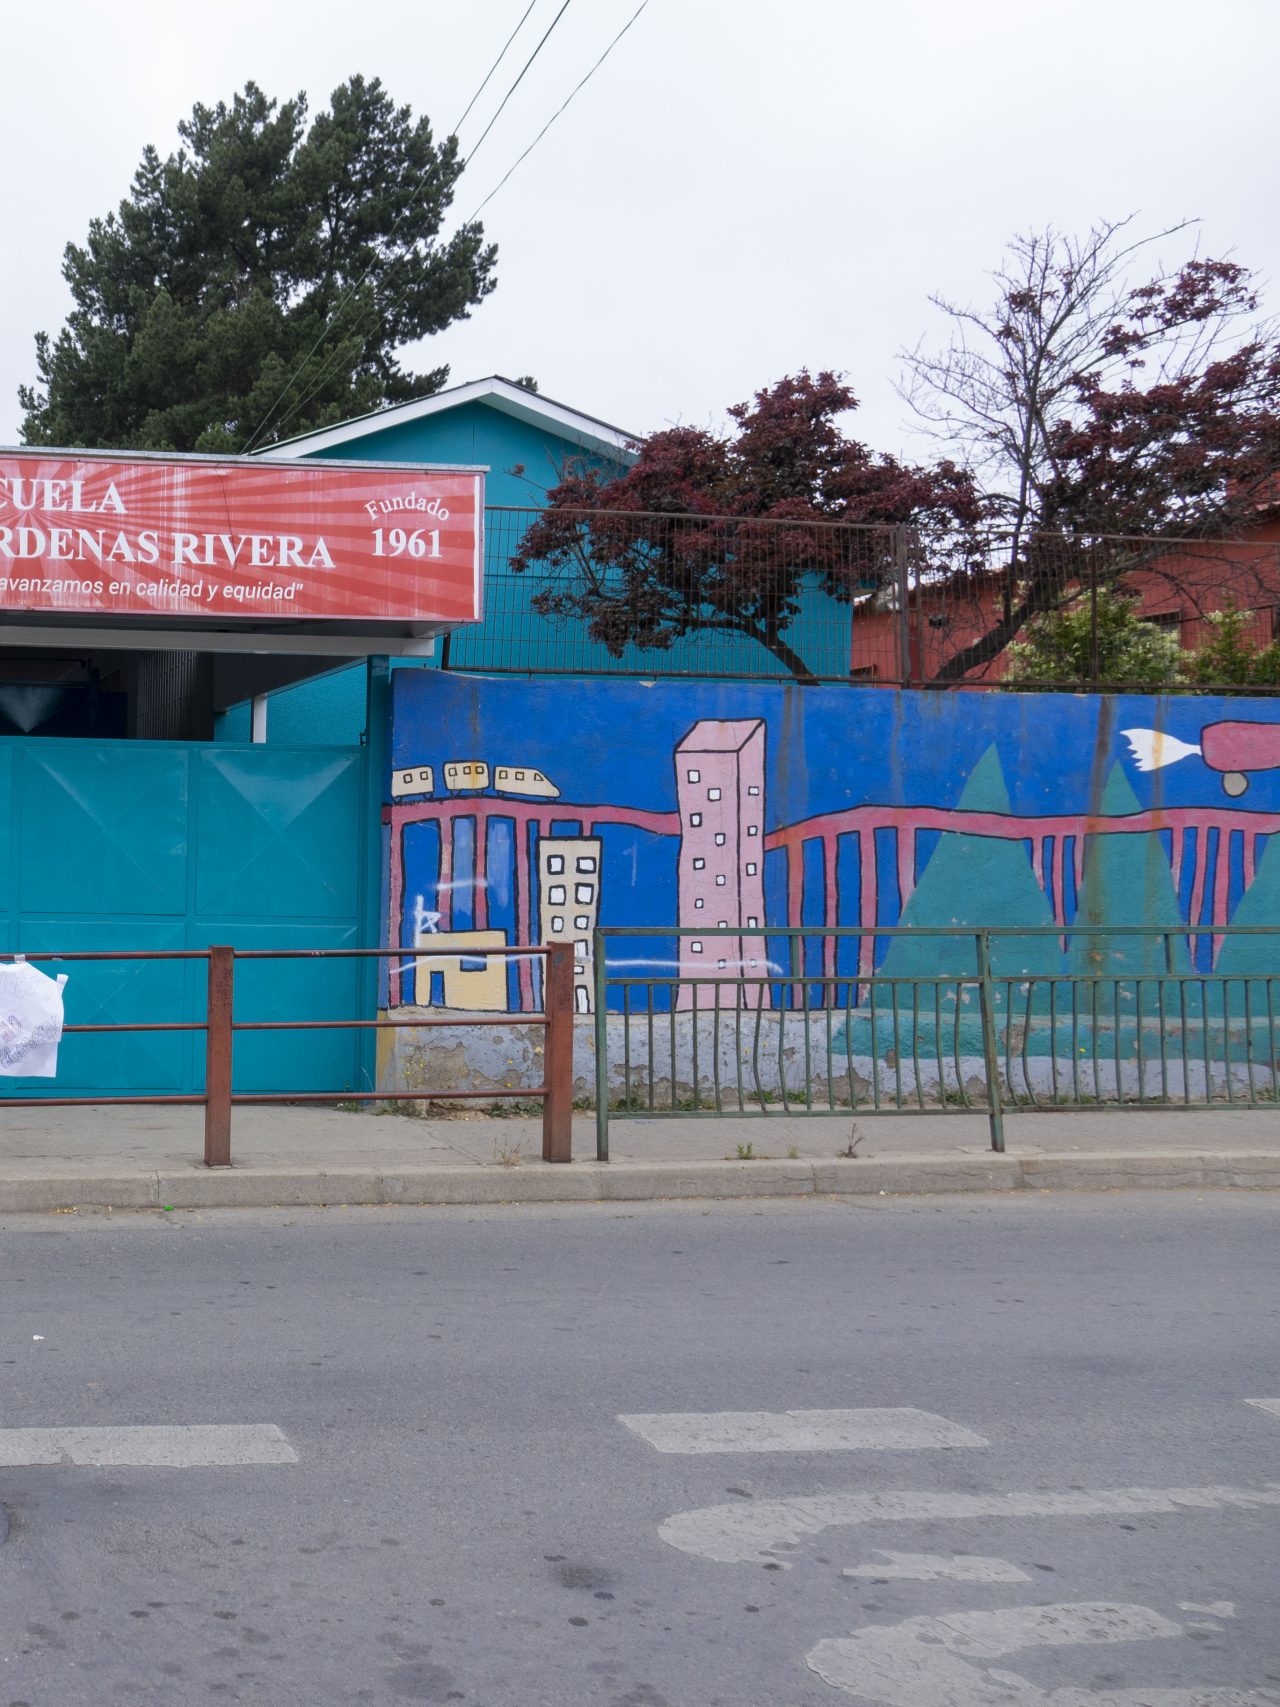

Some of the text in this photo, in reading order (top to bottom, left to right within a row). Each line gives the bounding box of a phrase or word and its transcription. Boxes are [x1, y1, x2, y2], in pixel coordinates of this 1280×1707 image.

[364, 491, 450, 521] Fundado
[171, 532, 336, 568] RIVERA
[371, 528, 442, 557] 1961
[108, 582, 131, 596] en
[136, 578, 203, 598] calidad
[206, 585, 218, 602] y
